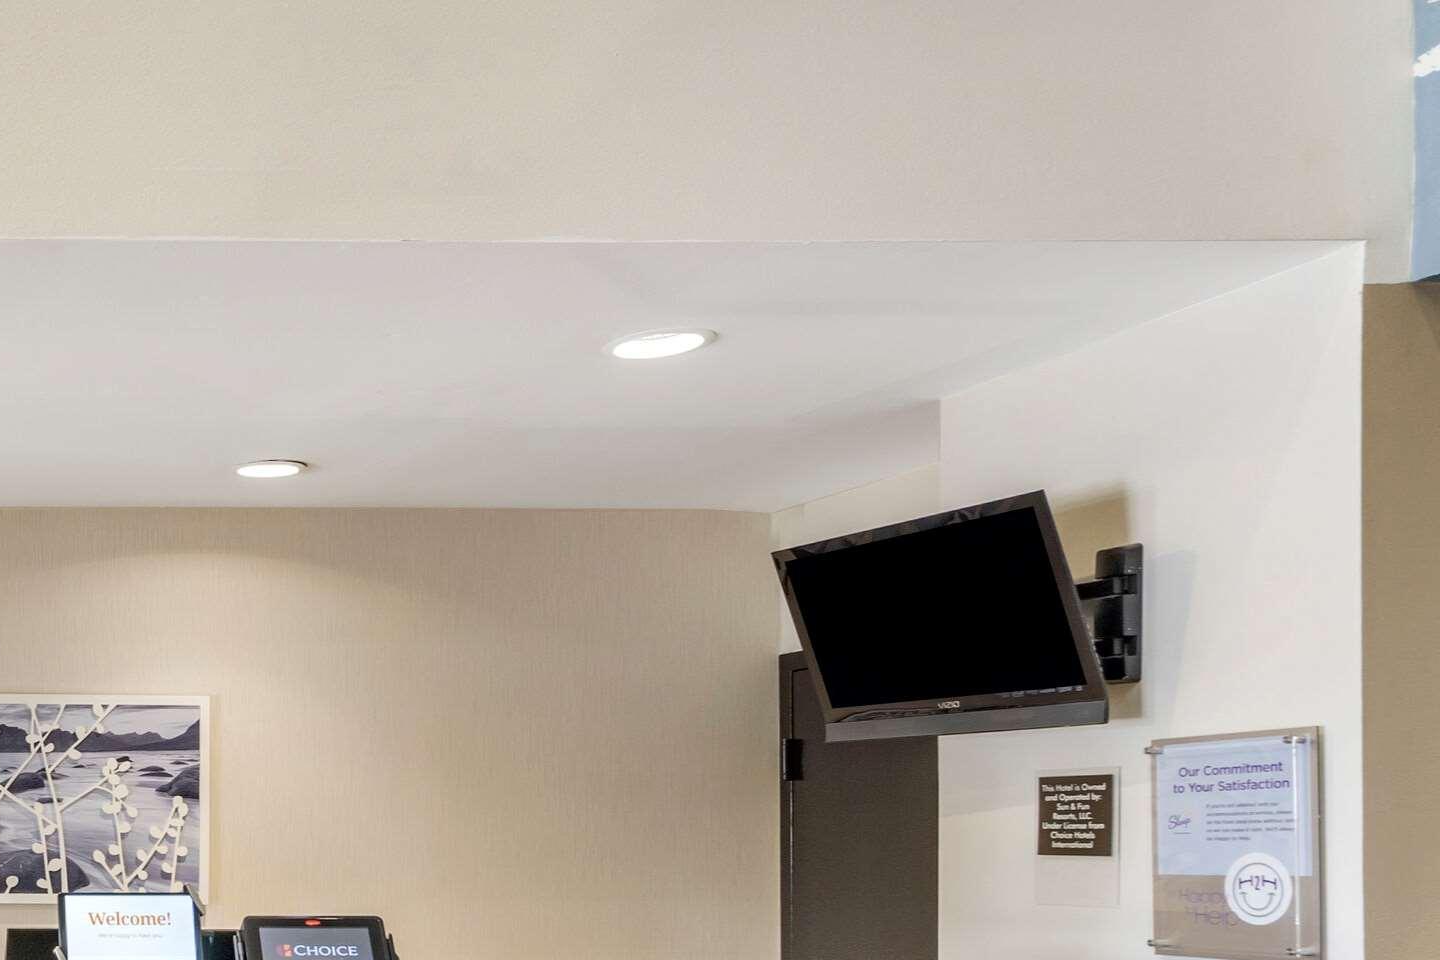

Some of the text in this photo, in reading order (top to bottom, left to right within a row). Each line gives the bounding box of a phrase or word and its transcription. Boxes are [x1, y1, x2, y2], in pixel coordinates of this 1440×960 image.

[1178, 762, 1283, 778] Our Commitment
[1041, 782, 1106, 792] This Hotel is Owned
[1173, 778, 1290, 794] to Your Satisfaction
[1045, 793, 1058, 801] and
[1059, 793, 1090, 802] Operated
[1070, 803, 1076, 811] &
[1042, 821, 1105, 829] Under License from
[1050, 830, 1096, 839] Choice Hotels
[1051, 841, 1094, 849] International
[1238, 874, 1277, 891] H2H
[88, 911, 172, 926] Welcome!
[293, 944, 359, 956] CHOICE
